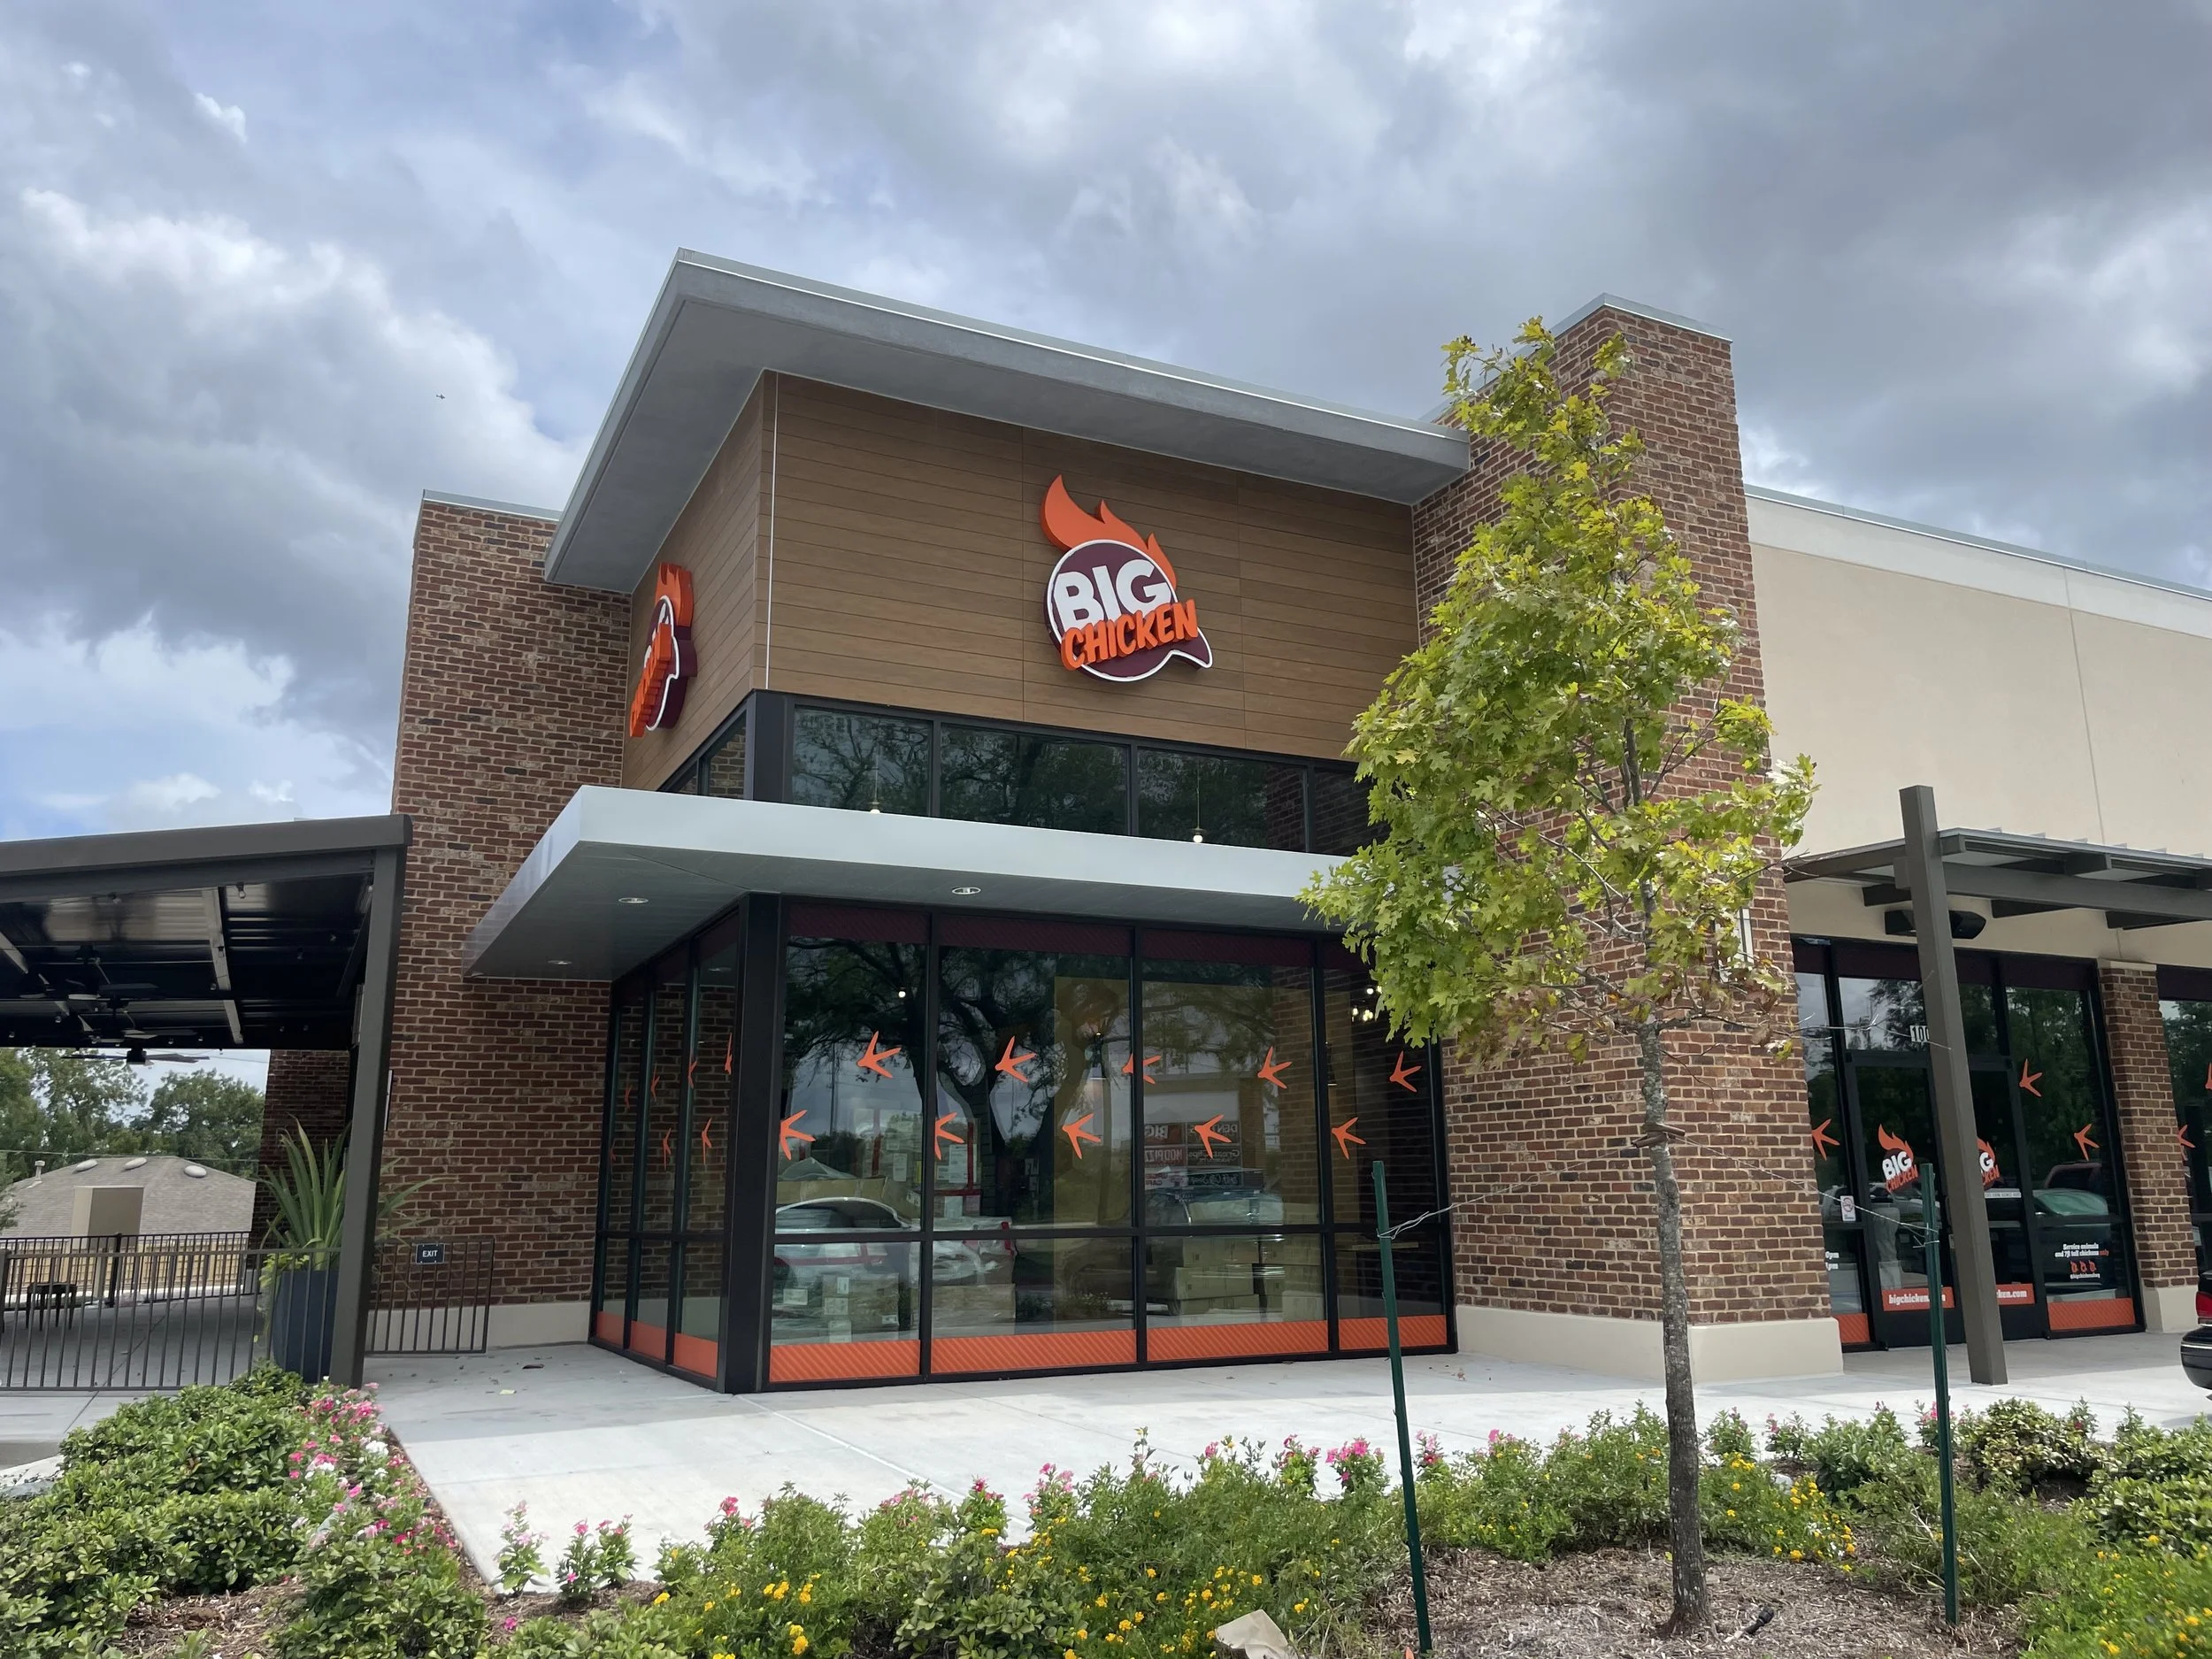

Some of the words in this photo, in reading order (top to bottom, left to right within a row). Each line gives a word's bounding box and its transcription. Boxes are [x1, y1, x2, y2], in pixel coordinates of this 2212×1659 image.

[1053, 558, 1172, 633] BIG
[1061, 599, 1199, 671] CHICKEN
[1882, 1151, 1911, 1180] BIG
[1886, 1164, 1918, 1194] CHICKEN
[1888, 1293, 1946, 1305] bigchicken.
